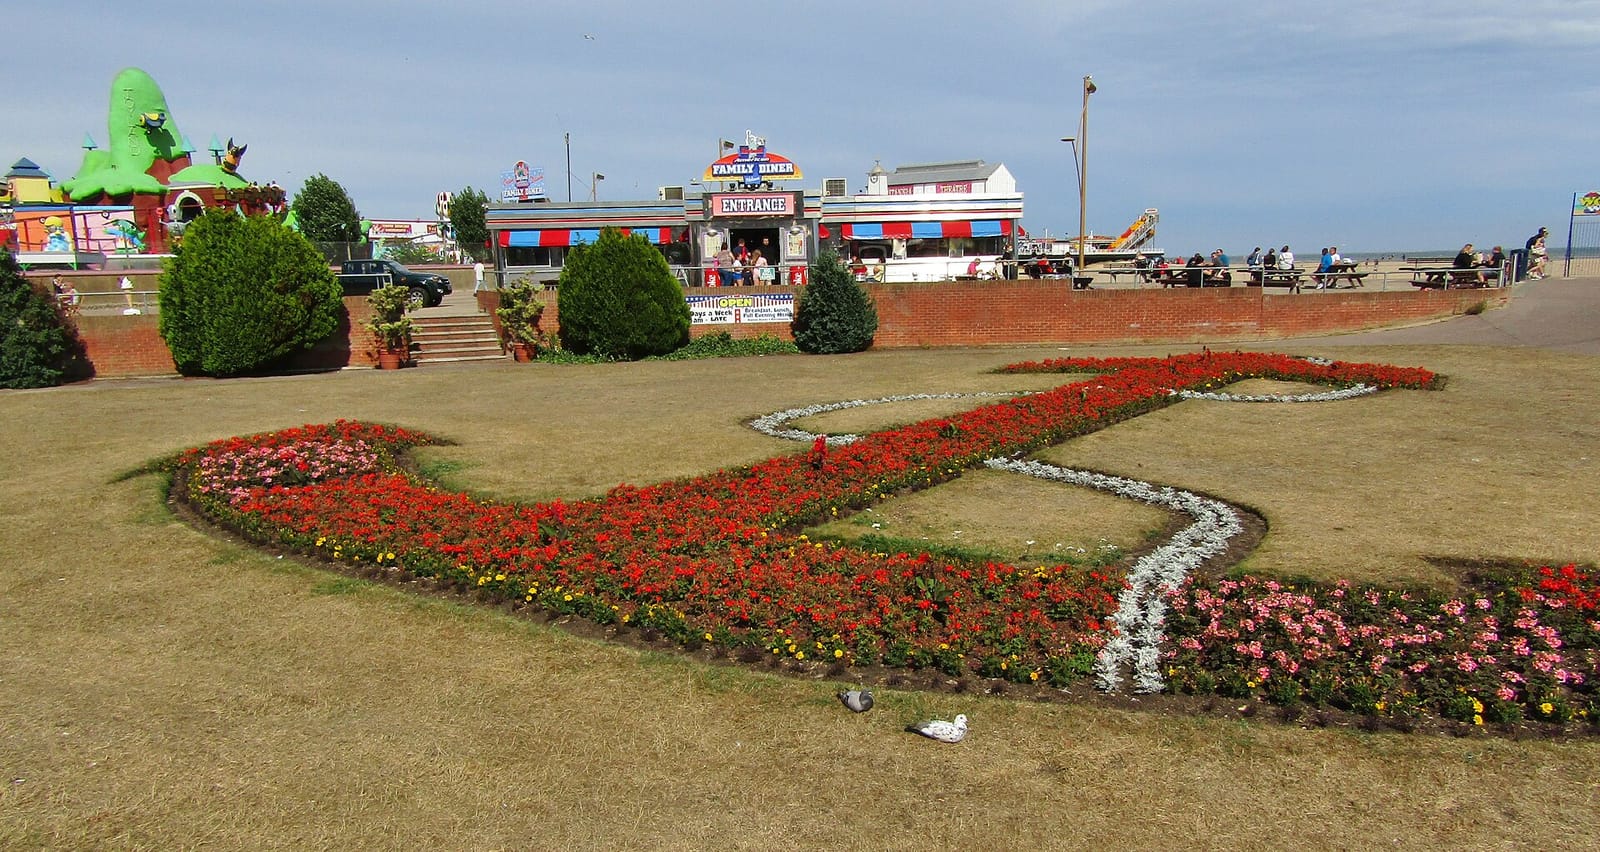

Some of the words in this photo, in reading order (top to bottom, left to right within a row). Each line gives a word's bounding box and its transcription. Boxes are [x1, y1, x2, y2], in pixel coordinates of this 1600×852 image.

[713, 164, 754, 174] FAMILY
[759, 162, 793, 173] DINER
[941, 183, 968, 193] THEATRE
[722, 198, 785, 212] ENTRANCE
[719, 298, 752, 308] OPEN
